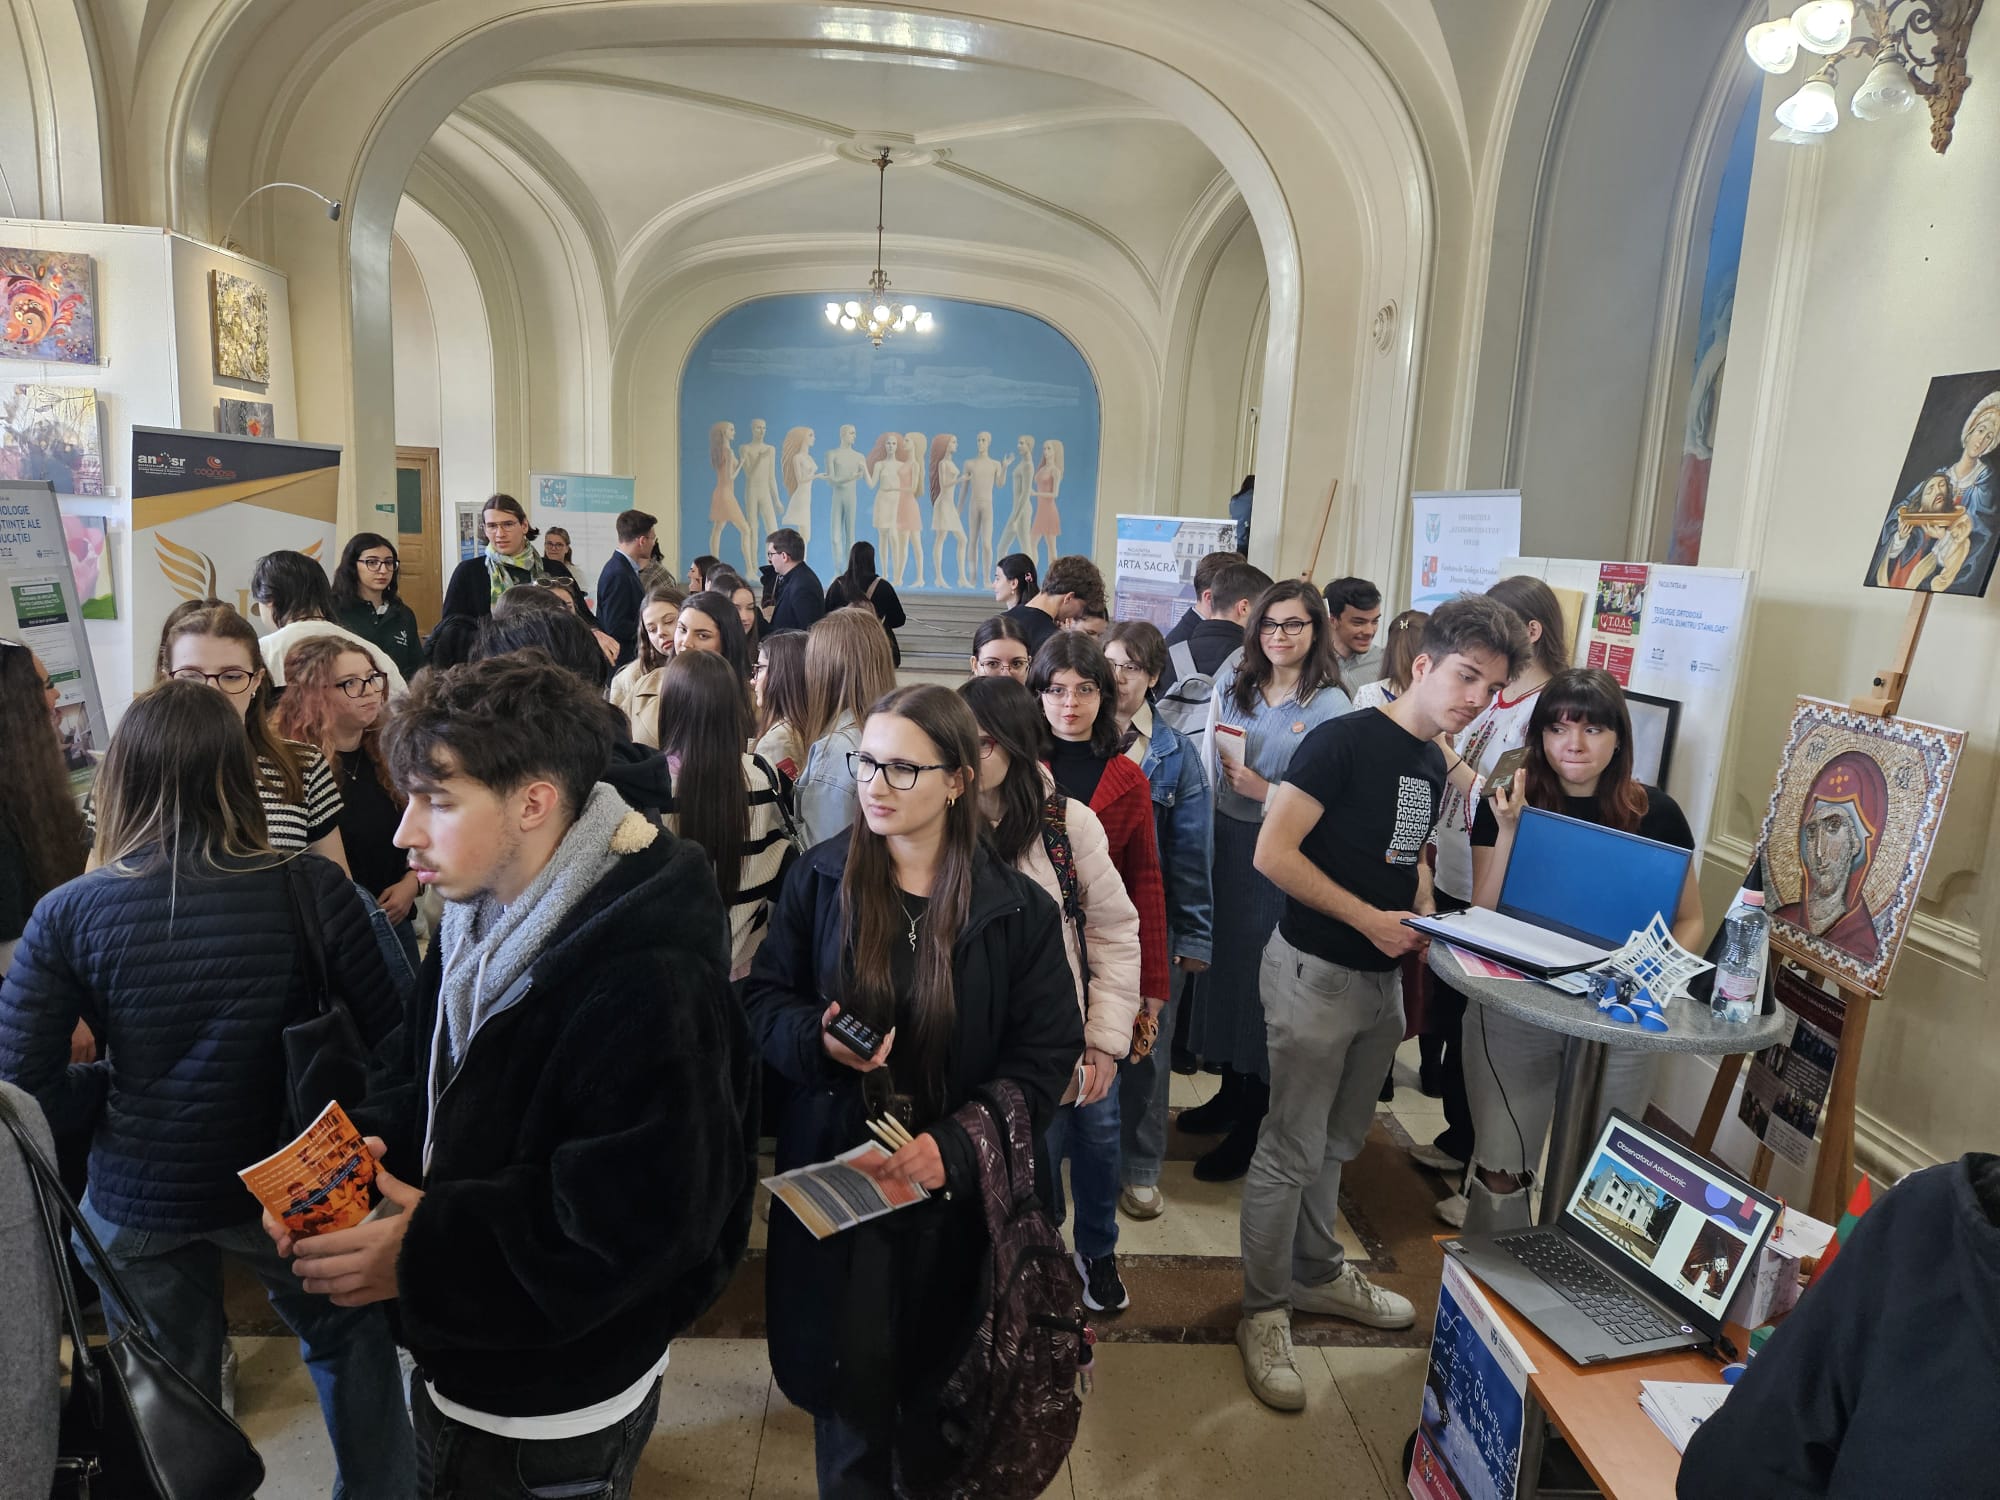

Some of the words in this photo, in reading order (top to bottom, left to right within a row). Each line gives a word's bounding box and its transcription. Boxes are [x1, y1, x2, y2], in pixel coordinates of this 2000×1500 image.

[0, 505, 31, 516] OLOGIE
[0, 519, 26, 531] TIINȚE
[27, 519, 42, 529] ALE
[0, 533, 31, 545] UCAȚIEI
[1118, 559, 1141, 570] ARTA
[1616, 1140, 1653, 1168] Observatorul
[1652, 1163, 1688, 1188] Astronomic
